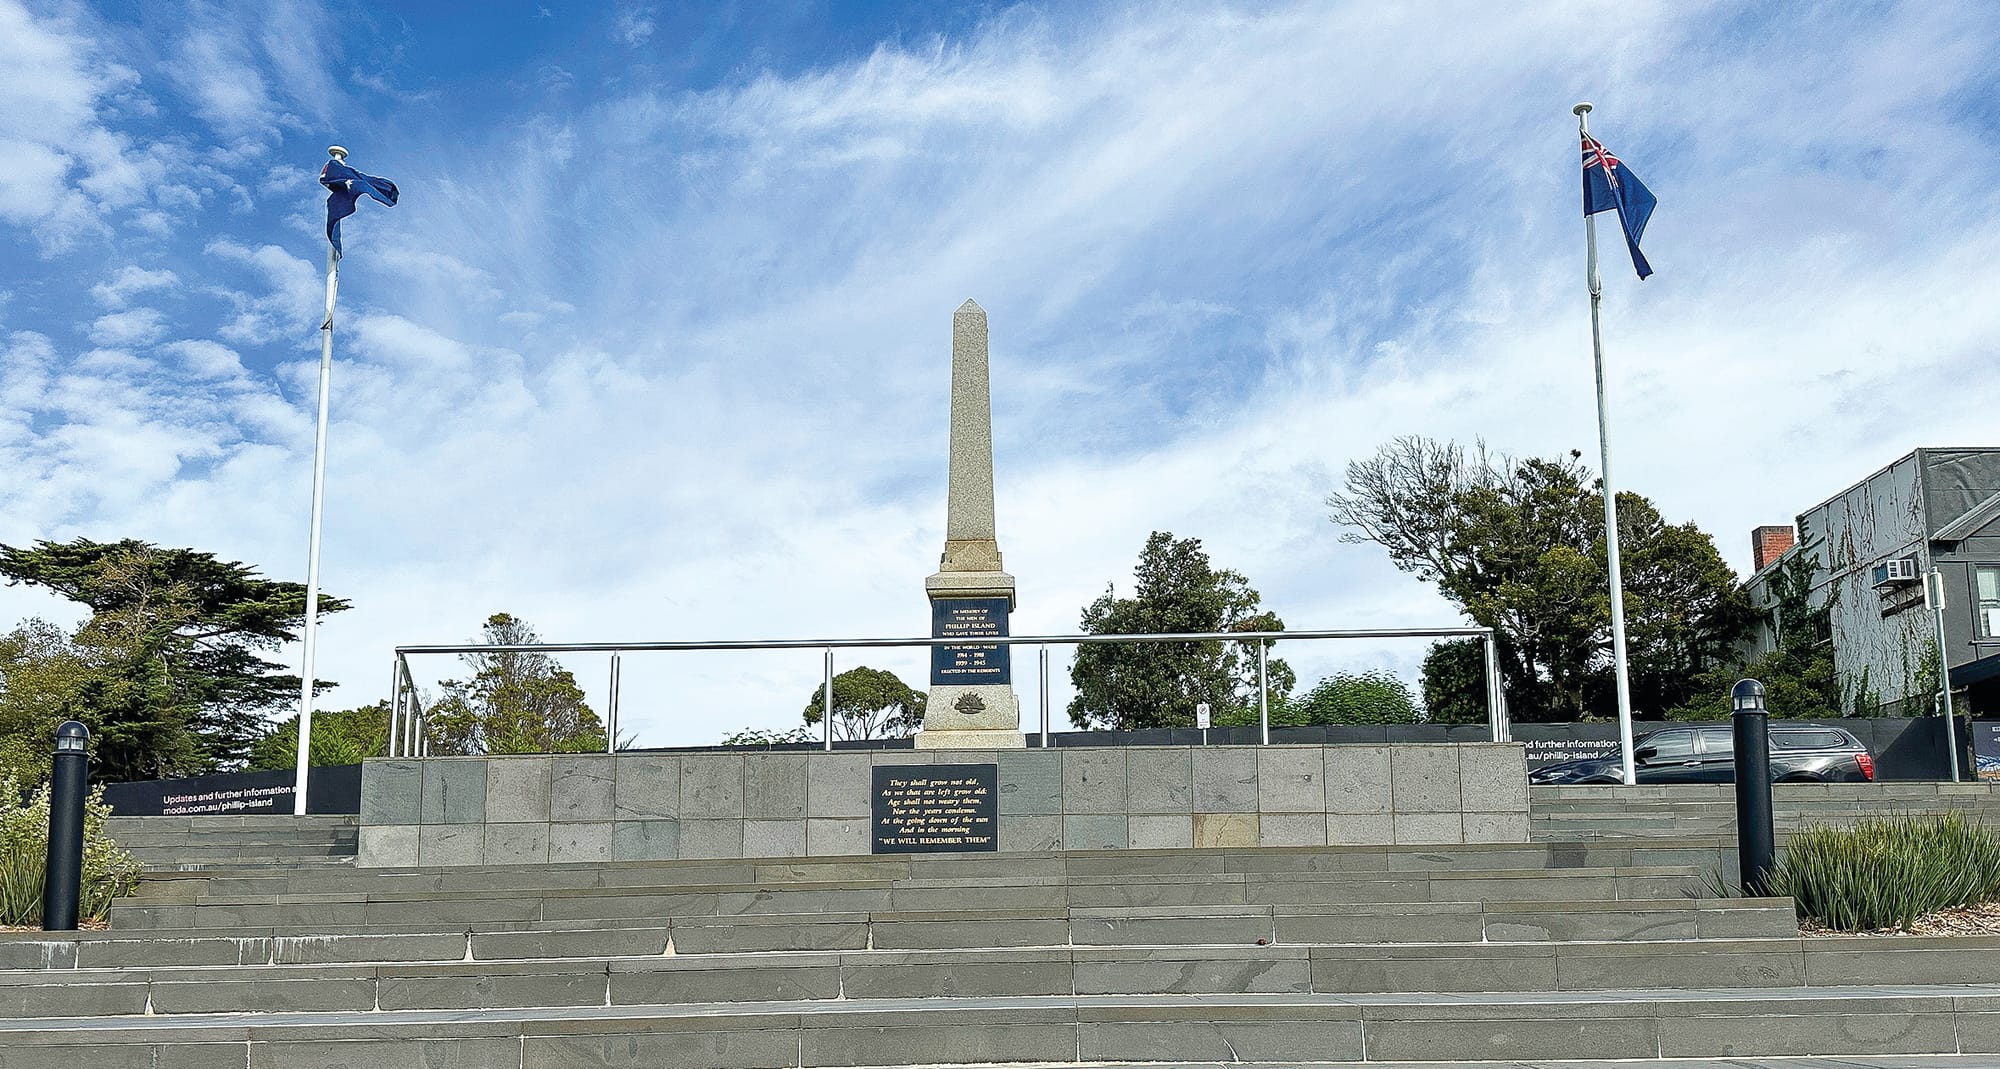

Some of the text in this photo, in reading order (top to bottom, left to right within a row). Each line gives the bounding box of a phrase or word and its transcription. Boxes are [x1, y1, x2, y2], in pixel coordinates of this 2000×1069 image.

[1567, 740, 1617, 748] information
[164, 796, 197, 805] Updates
[198, 792, 213, 801] and
[215, 790, 243, 799] further
[244, 786, 290, 796] information
[938, 789, 950, 797] left
[164, 798, 272, 814] moda.com.au/phillip-island
[951, 816, 959, 824] of
